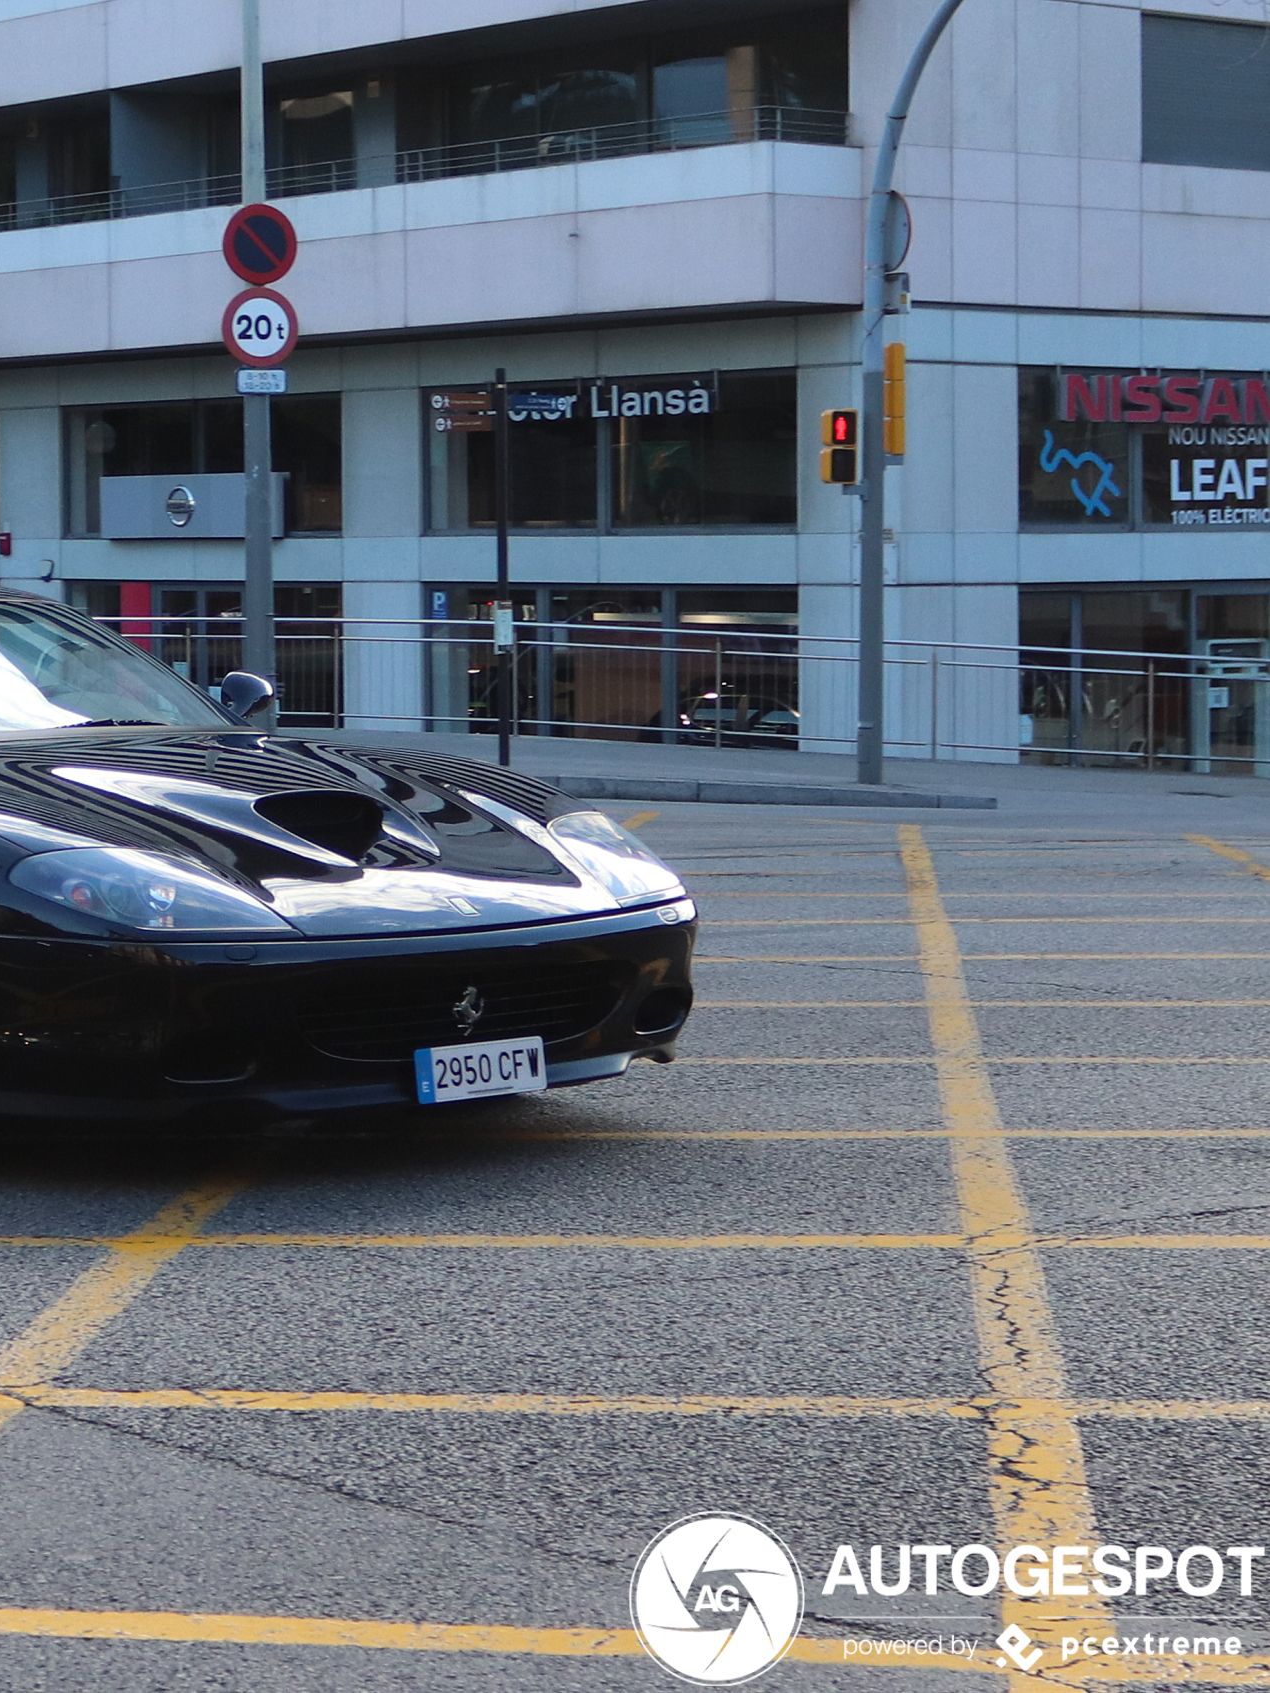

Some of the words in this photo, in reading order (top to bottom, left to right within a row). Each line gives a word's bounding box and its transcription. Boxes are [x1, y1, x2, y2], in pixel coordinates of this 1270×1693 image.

[236, 314, 271, 340] 20
[276, 323, 284, 340] t
[591, 380, 709, 418] Llansà
[1059, 374, 1270, 424] NISSAN
[1168, 428, 1206, 446] NOU
[1211, 426, 1270, 445] NISSAN
[1169, 458, 1269, 501] LEAF
[1171, 510, 1205, 525] 100%
[435, 1053, 492, 1089] 2950
[498, 1047, 539, 1080] CFW
[422, 1081, 430, 1093] E
